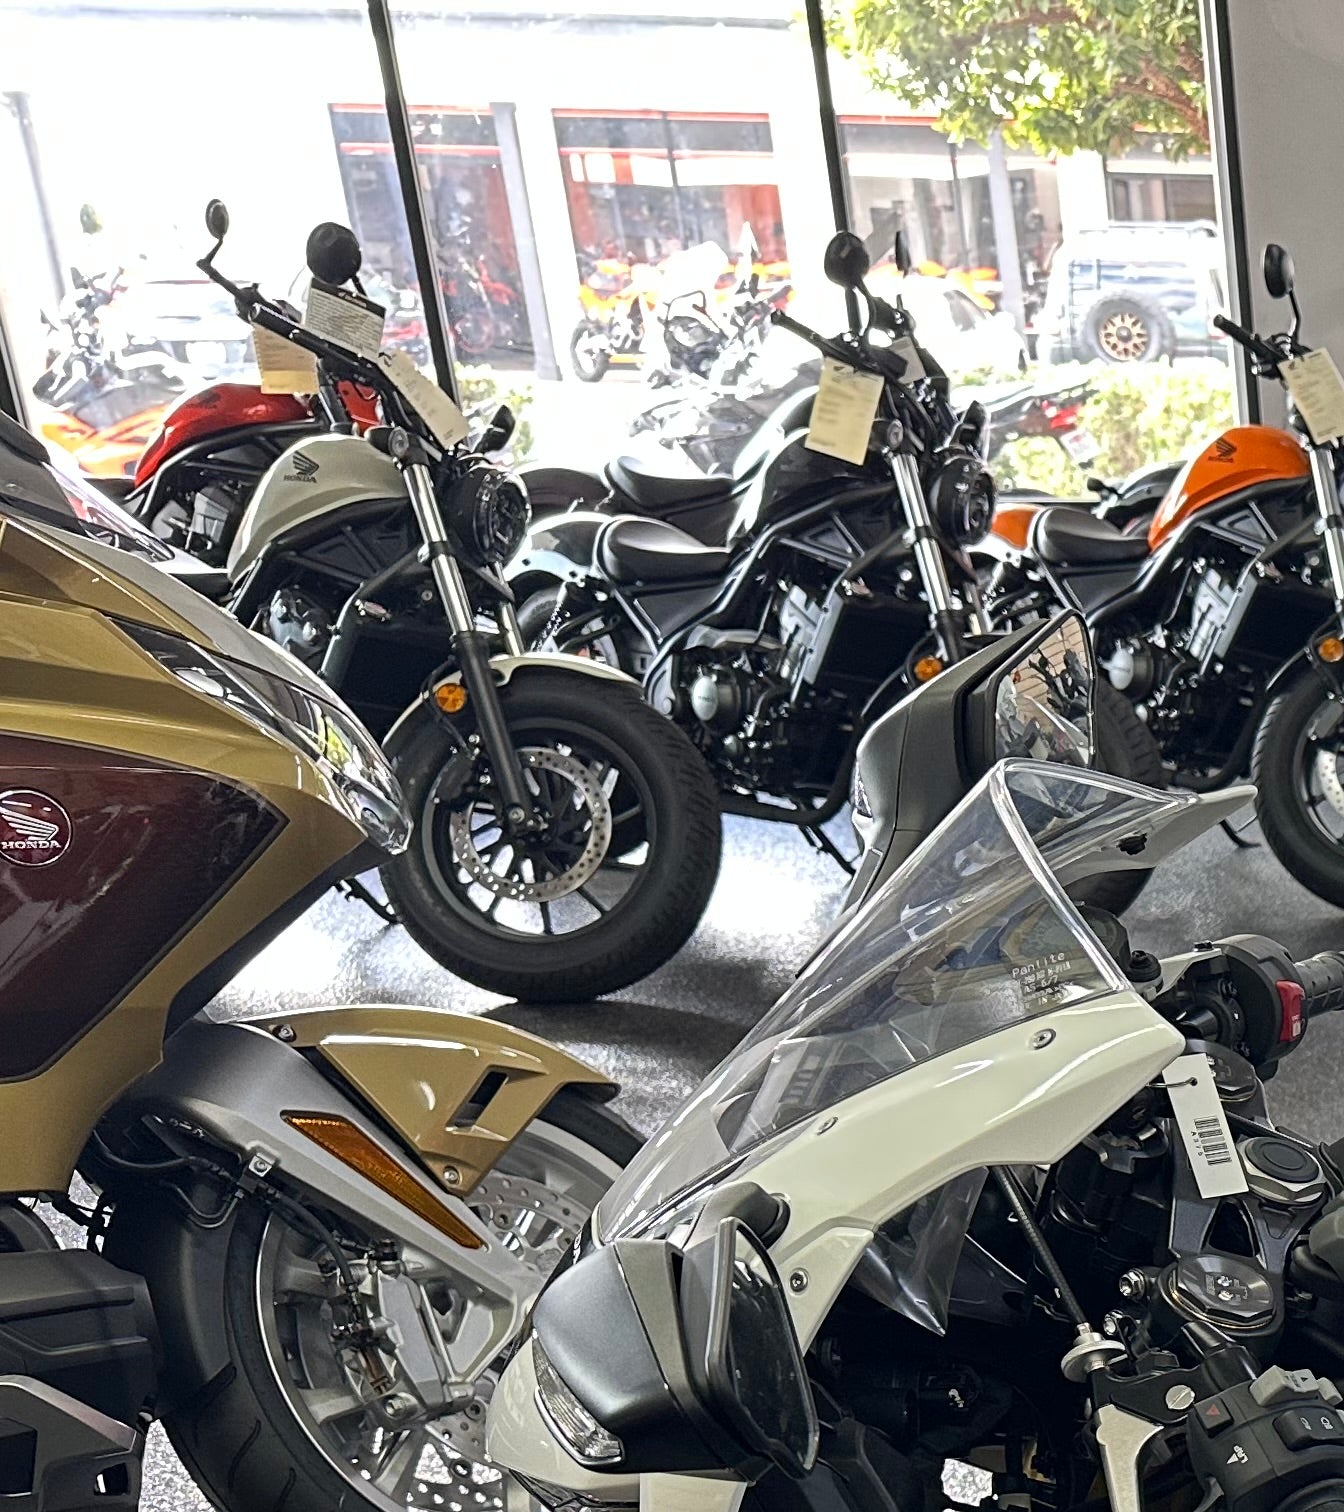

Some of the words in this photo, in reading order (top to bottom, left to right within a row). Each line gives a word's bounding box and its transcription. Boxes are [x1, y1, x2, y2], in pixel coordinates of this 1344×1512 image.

[1, 840, 61, 849] HONDA
[1012, 952, 1065, 978] Panlite
[1234, 1445, 1249, 1464] LAP
